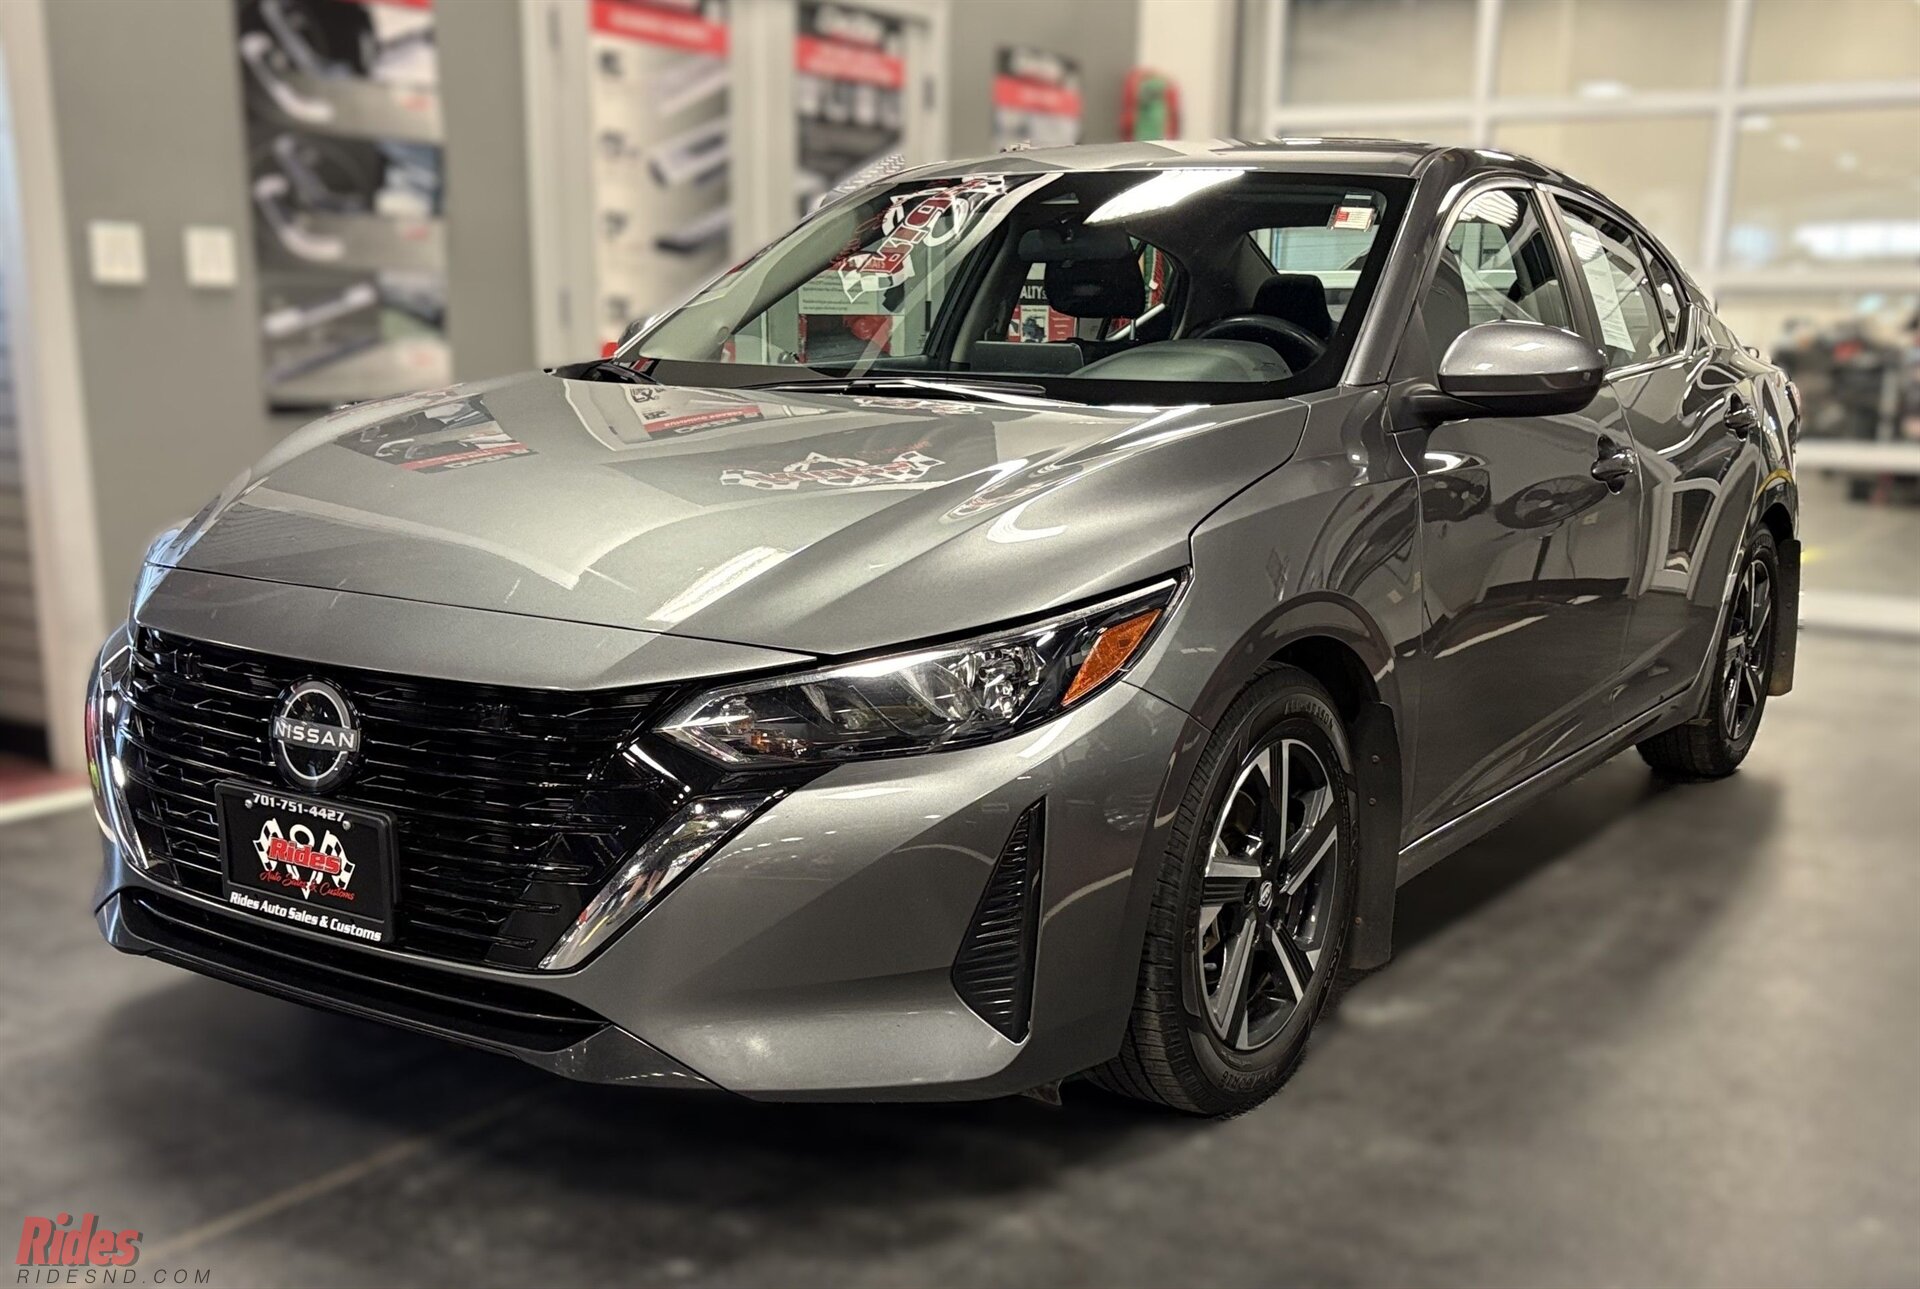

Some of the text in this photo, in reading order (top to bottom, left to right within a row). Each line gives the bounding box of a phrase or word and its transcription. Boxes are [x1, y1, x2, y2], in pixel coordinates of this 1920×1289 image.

[275, 721, 355, 749] NISSAN
[253, 793, 345, 822] 701-751-4427
[268, 836, 342, 875] Rides
[259, 870, 282, 883] Auto
[319, 883, 356, 901] Customs
[229, 891, 382, 942] Rides Auto Sales & Customs
